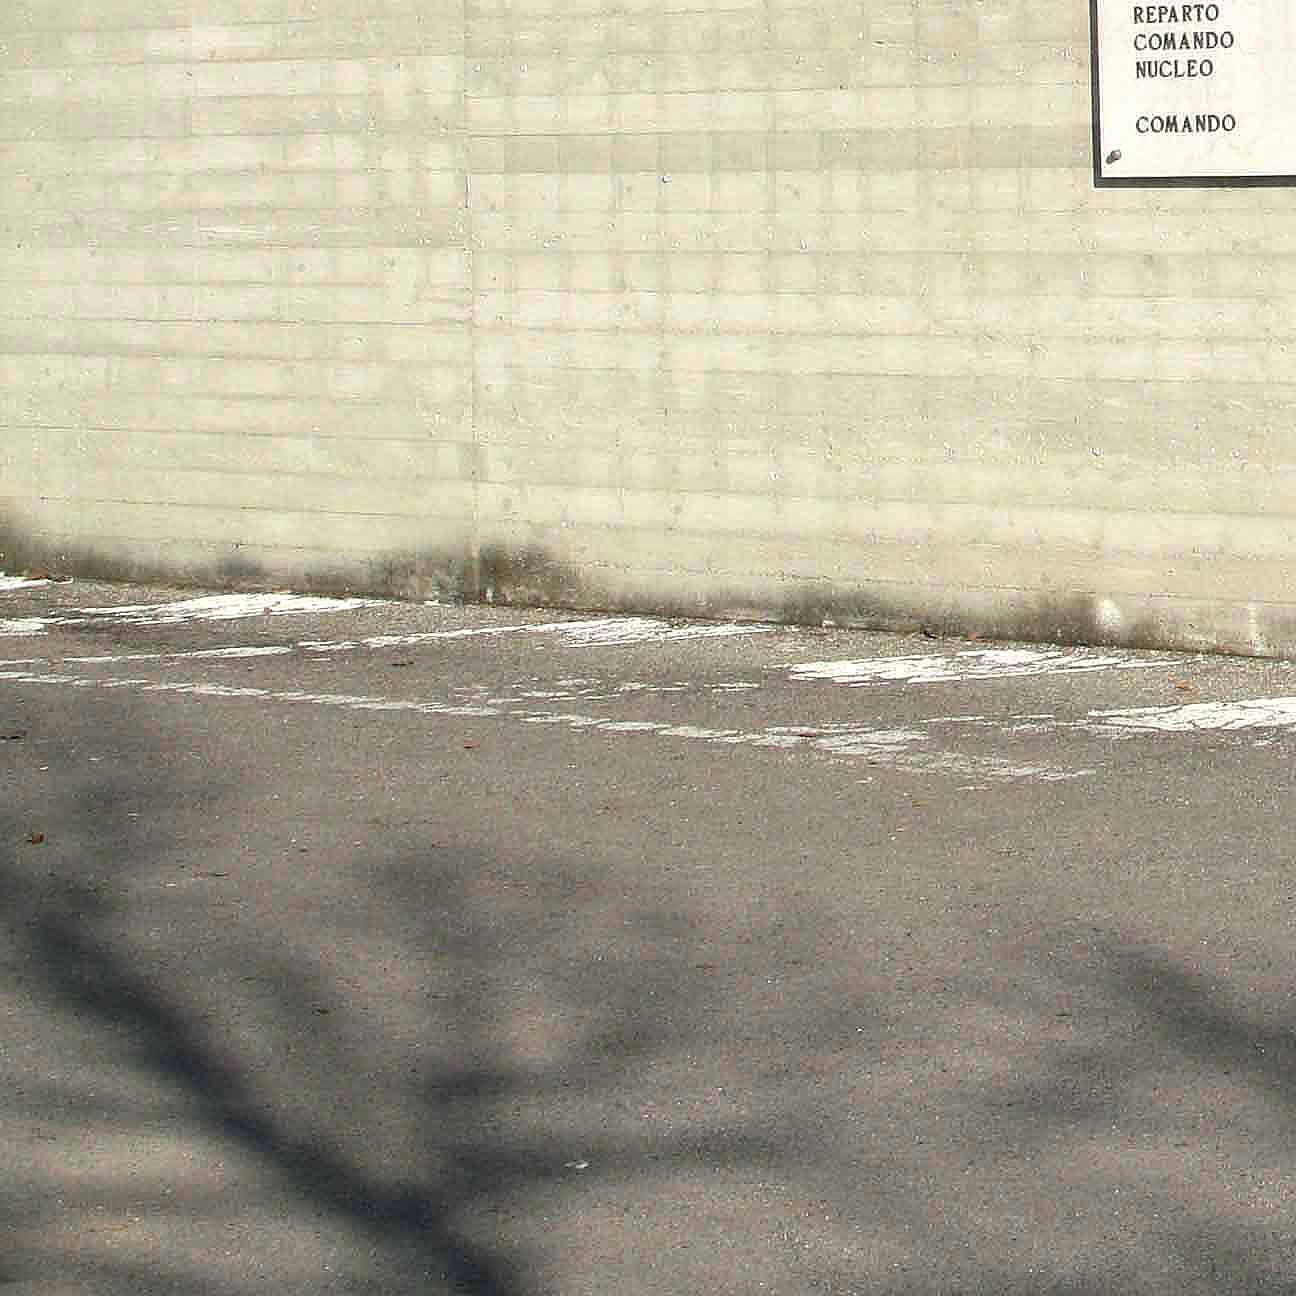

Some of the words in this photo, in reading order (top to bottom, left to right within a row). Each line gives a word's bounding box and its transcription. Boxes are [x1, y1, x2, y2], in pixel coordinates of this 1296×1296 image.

[1133, 3, 1219, 24] REPARTO
[1133, 31, 1235, 51] COMANDO
[1135, 58, 1214, 79] NUCLEO
[1135, 114, 1236, 134] COMANDO
